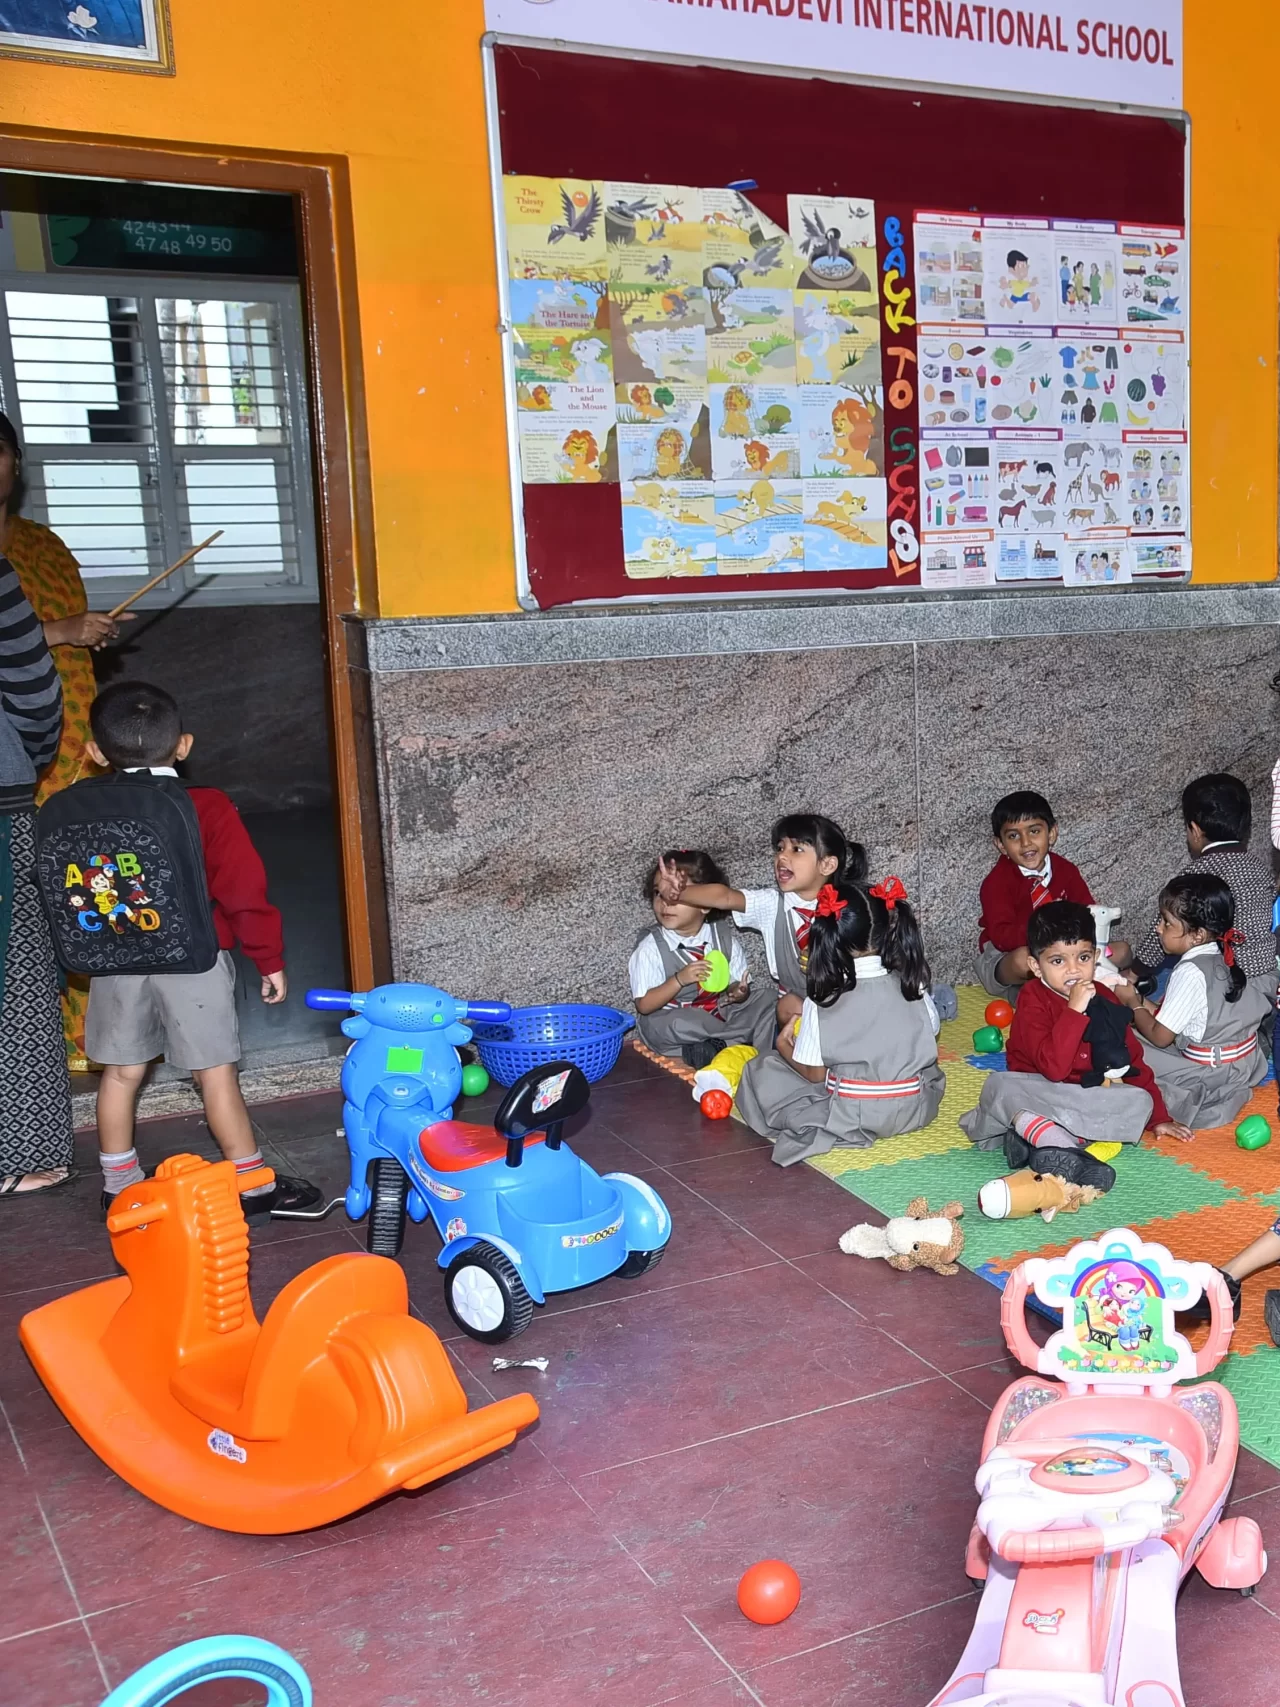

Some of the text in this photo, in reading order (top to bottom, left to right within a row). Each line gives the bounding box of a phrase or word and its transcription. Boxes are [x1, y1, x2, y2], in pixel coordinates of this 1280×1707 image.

[853, 0, 1069, 52] INTERNATIONAL
[1076, 19, 1174, 66] SCHOOL
[520, 188, 538, 196] The
[515, 196, 544, 206] Thirsty
[519, 206, 541, 214] Crow
[122, 220, 144, 235] 42
[135, 234, 232, 255] 47 48 49 50
[540, 310, 556, 319] The
[559, 311, 579, 319] Hare
[568, 385, 605, 393] The Lion
[883, 216, 920, 578] BACK TO SCHOOL
[582, 403, 608, 411] Mouse
[65, 853, 142, 888] A B
[77, 908, 161, 932] C D
